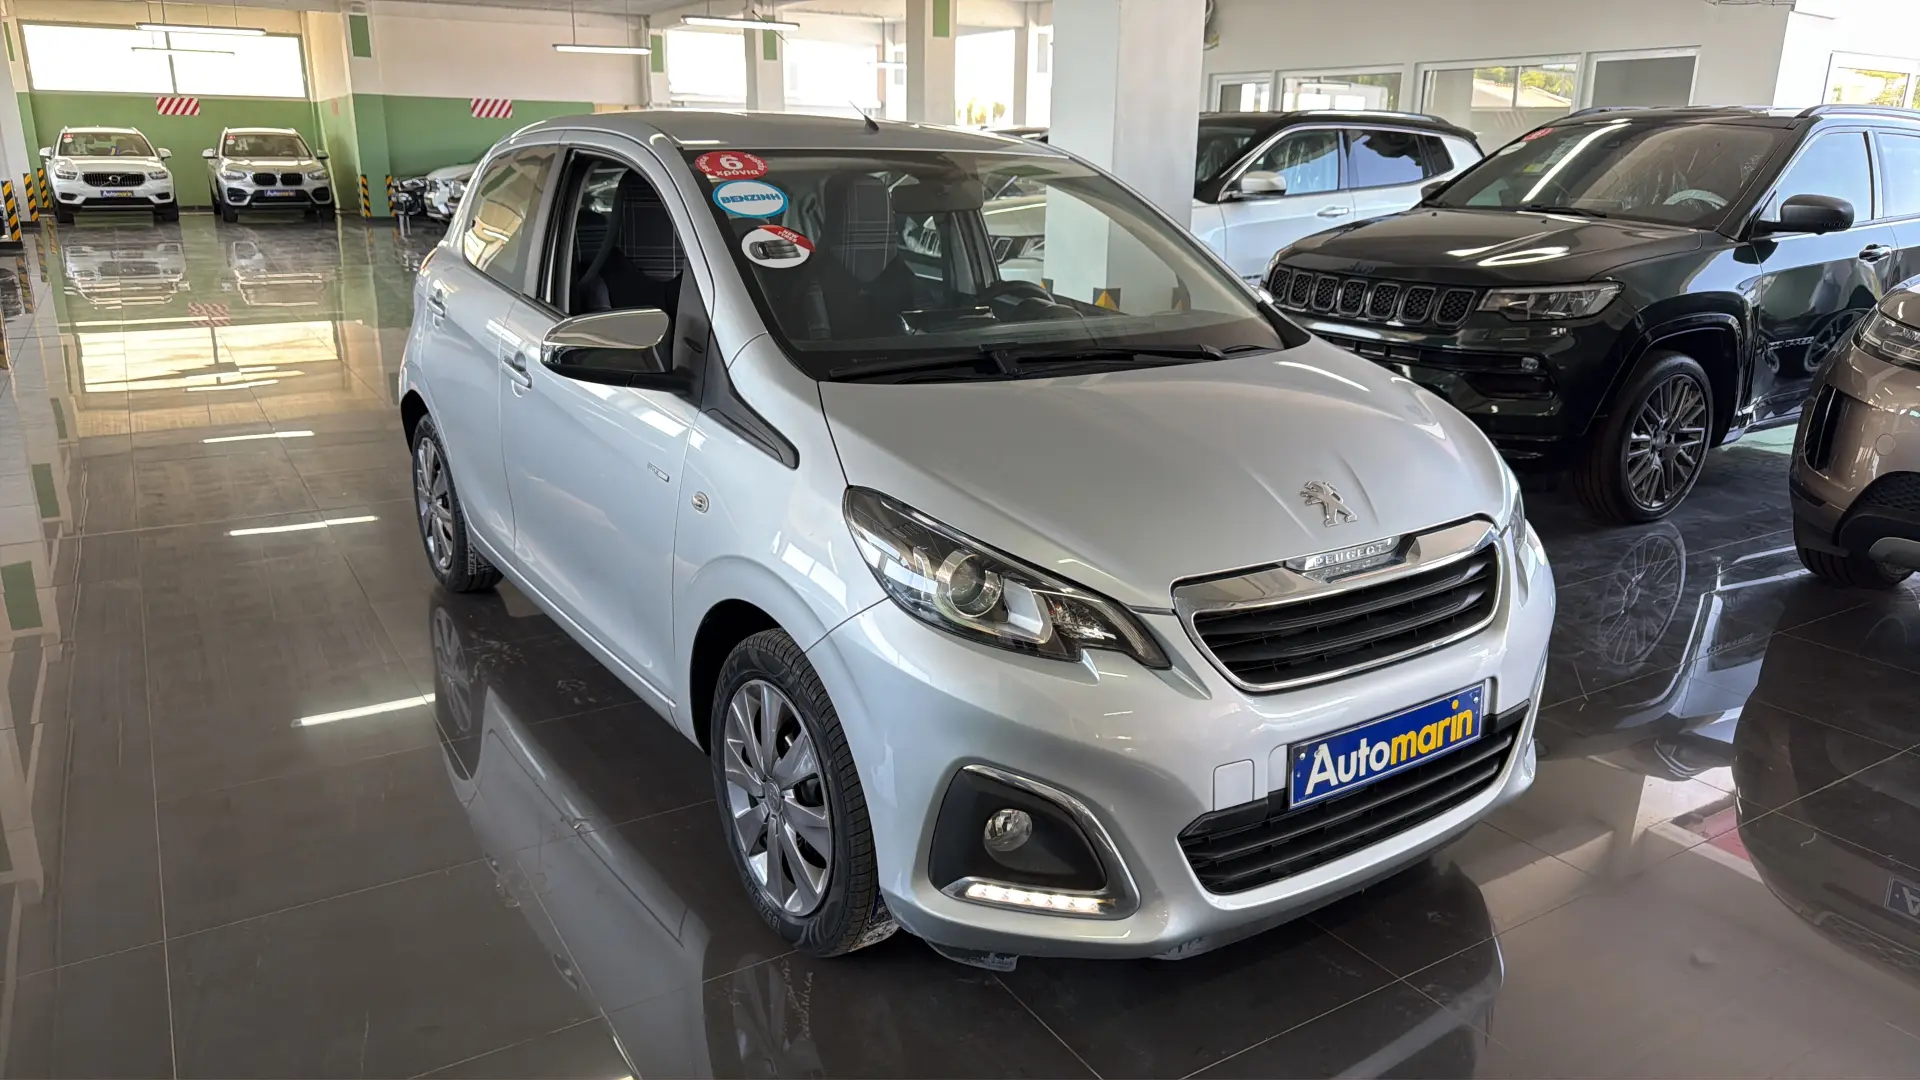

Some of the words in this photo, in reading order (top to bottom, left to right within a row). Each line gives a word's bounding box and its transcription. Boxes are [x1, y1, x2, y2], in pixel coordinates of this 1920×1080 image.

[715, 168, 760, 177] χρόνια
[719, 156, 743, 170] 6
[1315, 542, 1384, 567] PEUGEOT
[1305, 699, 1473, 796] Automarin
